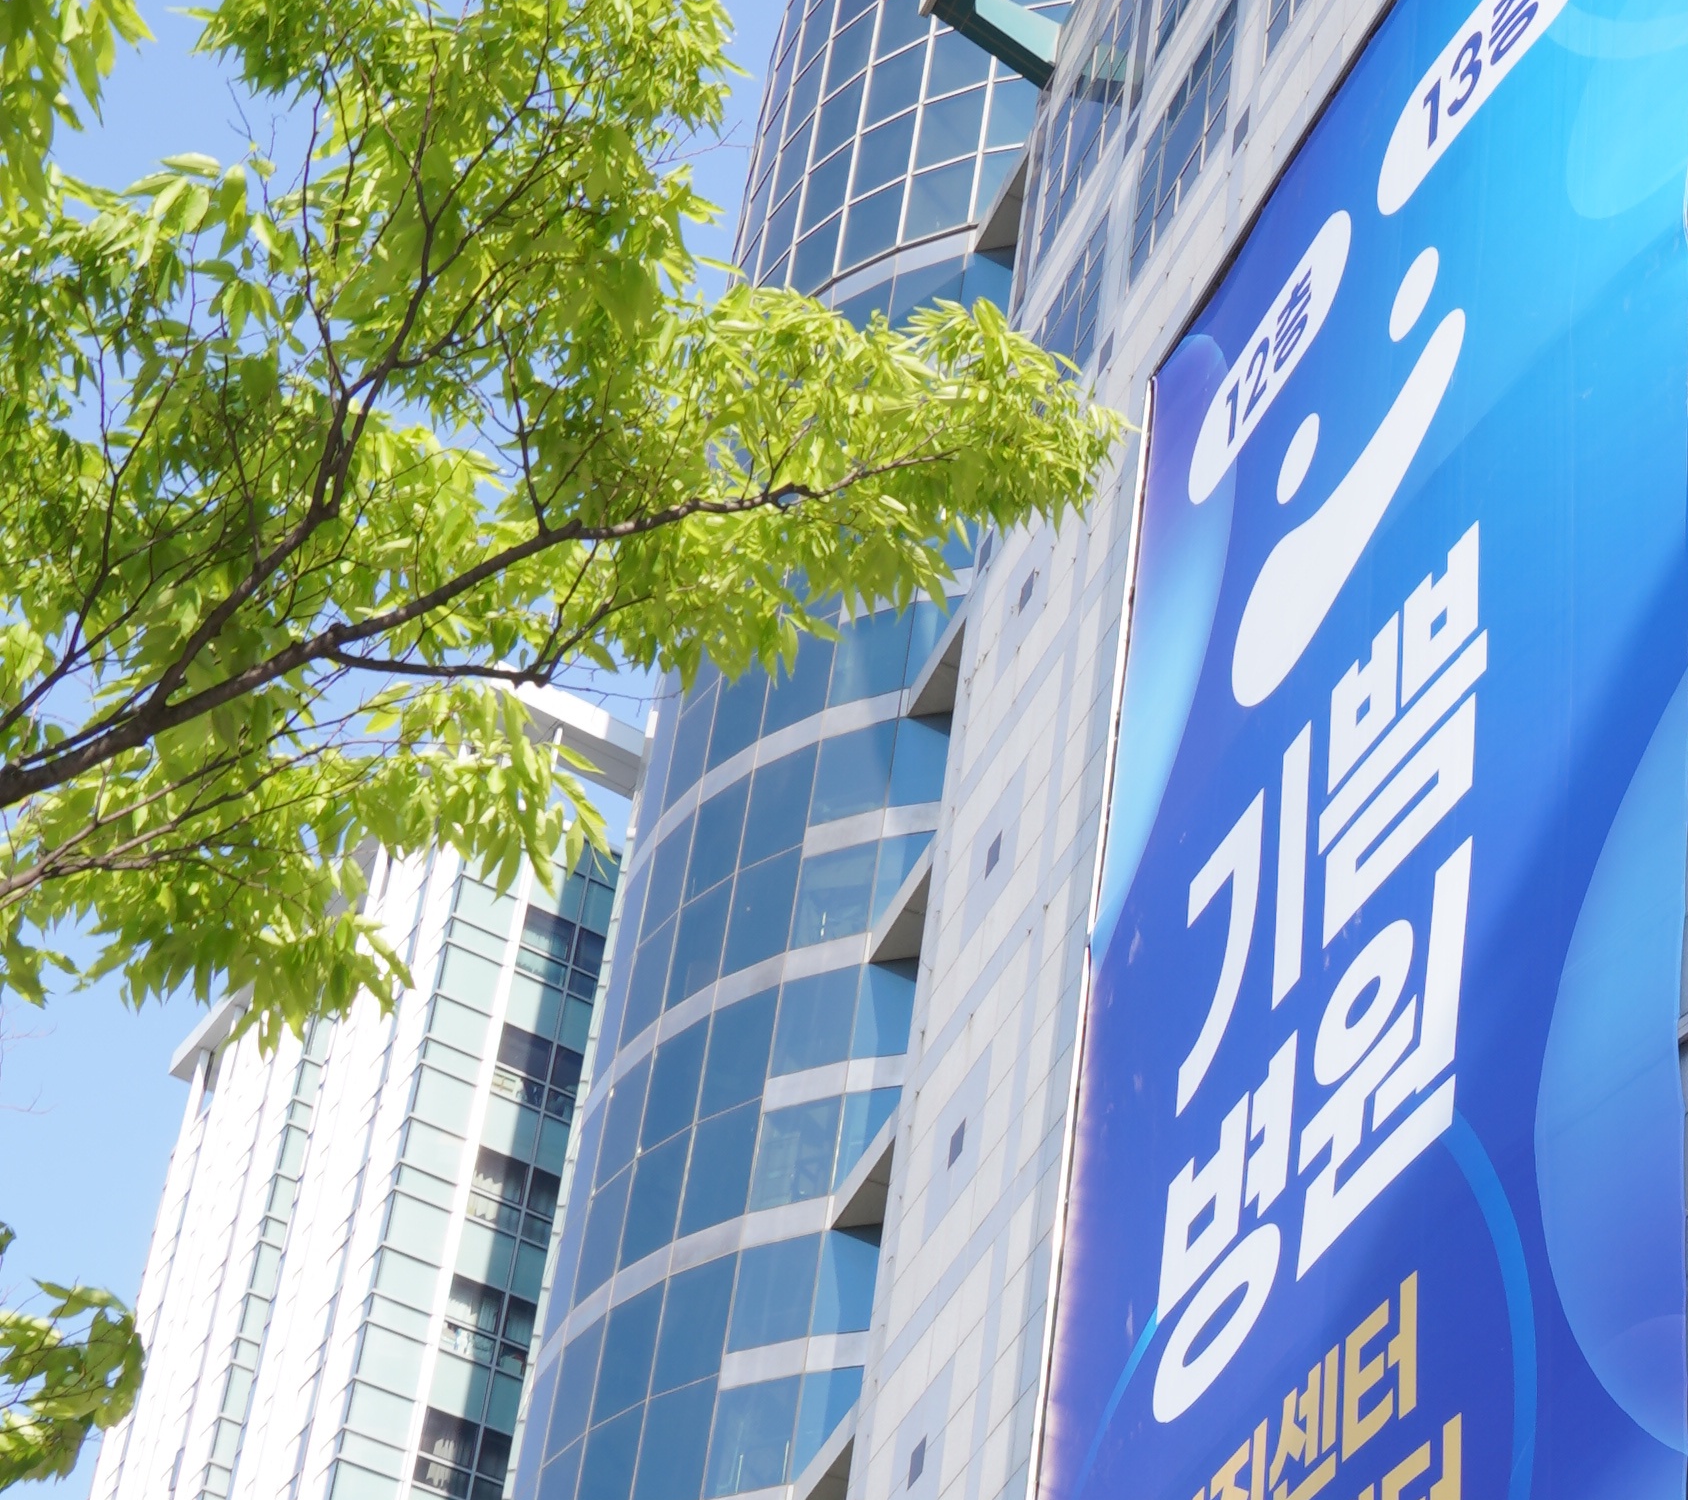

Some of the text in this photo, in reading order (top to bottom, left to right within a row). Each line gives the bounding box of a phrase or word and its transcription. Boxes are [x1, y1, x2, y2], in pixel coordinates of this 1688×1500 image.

[1225, 264, 1313, 449] 12층
[1176, 520, 1488, 1117] 기쁨
[1151, 835, 1474, 1425] 병원
